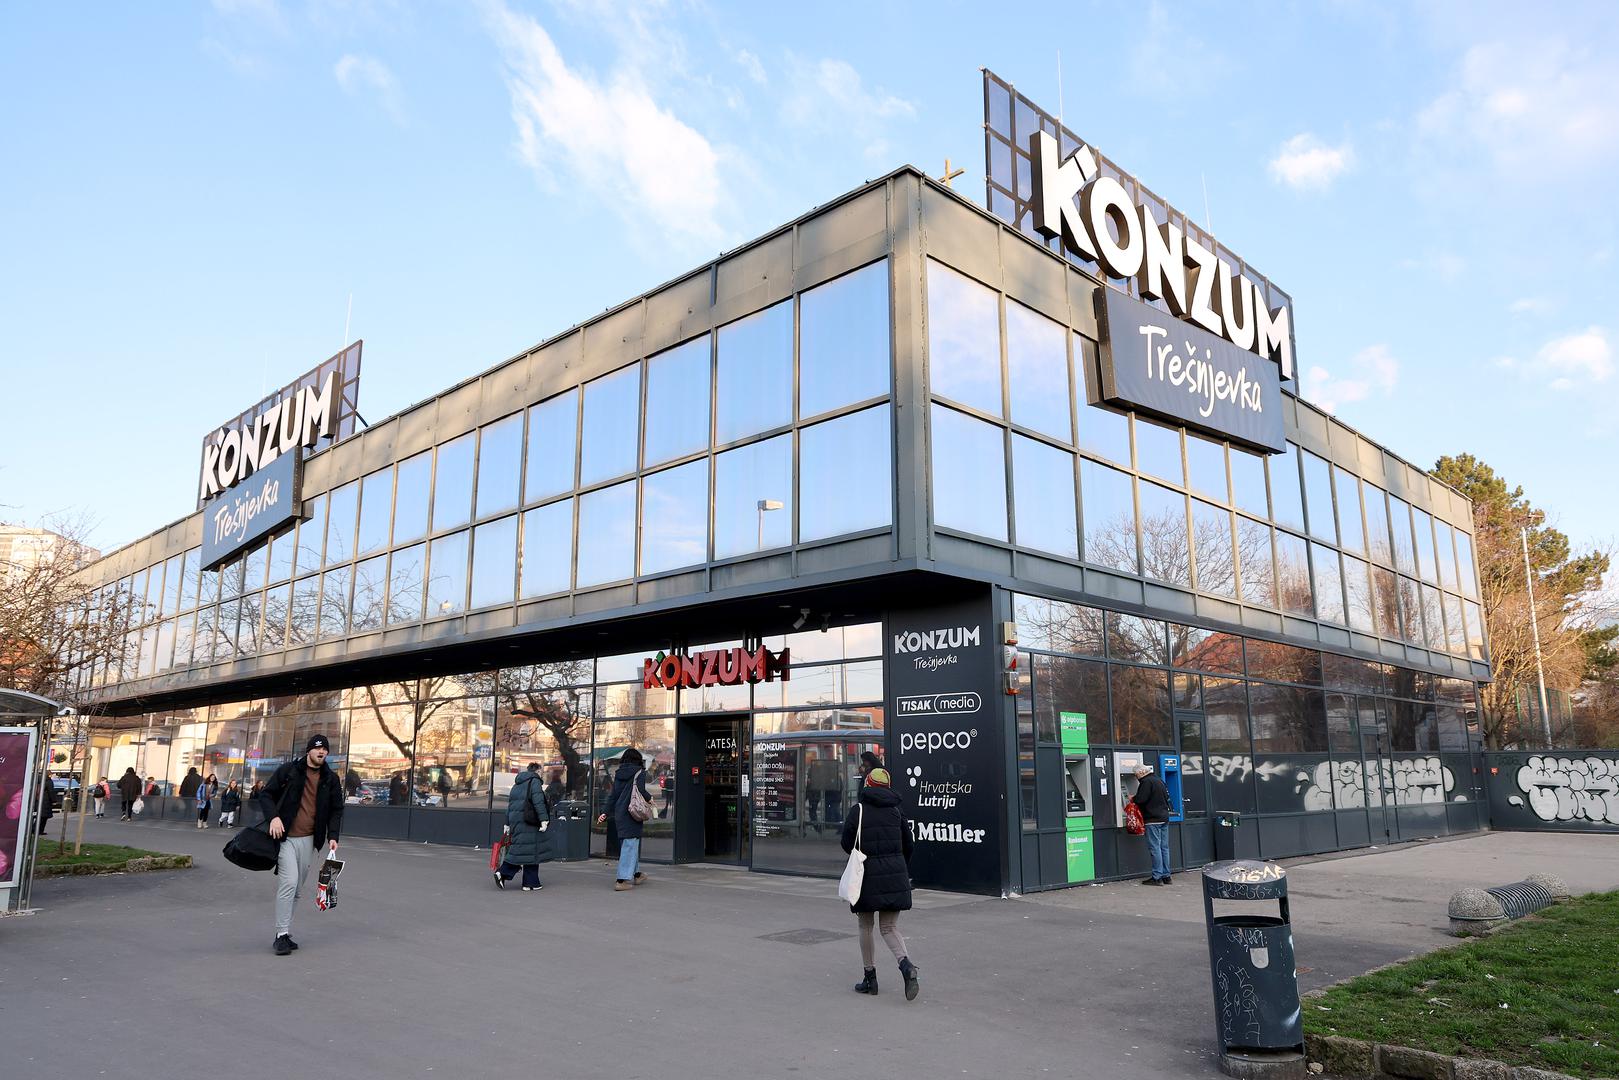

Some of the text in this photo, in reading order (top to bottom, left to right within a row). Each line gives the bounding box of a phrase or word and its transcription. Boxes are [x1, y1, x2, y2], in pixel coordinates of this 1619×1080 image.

[1031, 130, 1292, 381] KONZUM
[1139, 324, 1263, 418] Trešnjevka
[201, 371, 340, 500] KONZUM
[213, 478, 279, 546] Trešnjevka
[894, 625, 981, 654] KONZUM
[643, 644, 767, 689] KONZUM
[913, 654, 958, 672] Trešnjevka
[901, 696, 975, 712] TISAK media
[757, 742, 786, 751] KONZUM
[919, 780, 973, 795] Hrvatska
[918, 794, 957, 810] Lutrija
[917, 821, 986, 844] Müller
